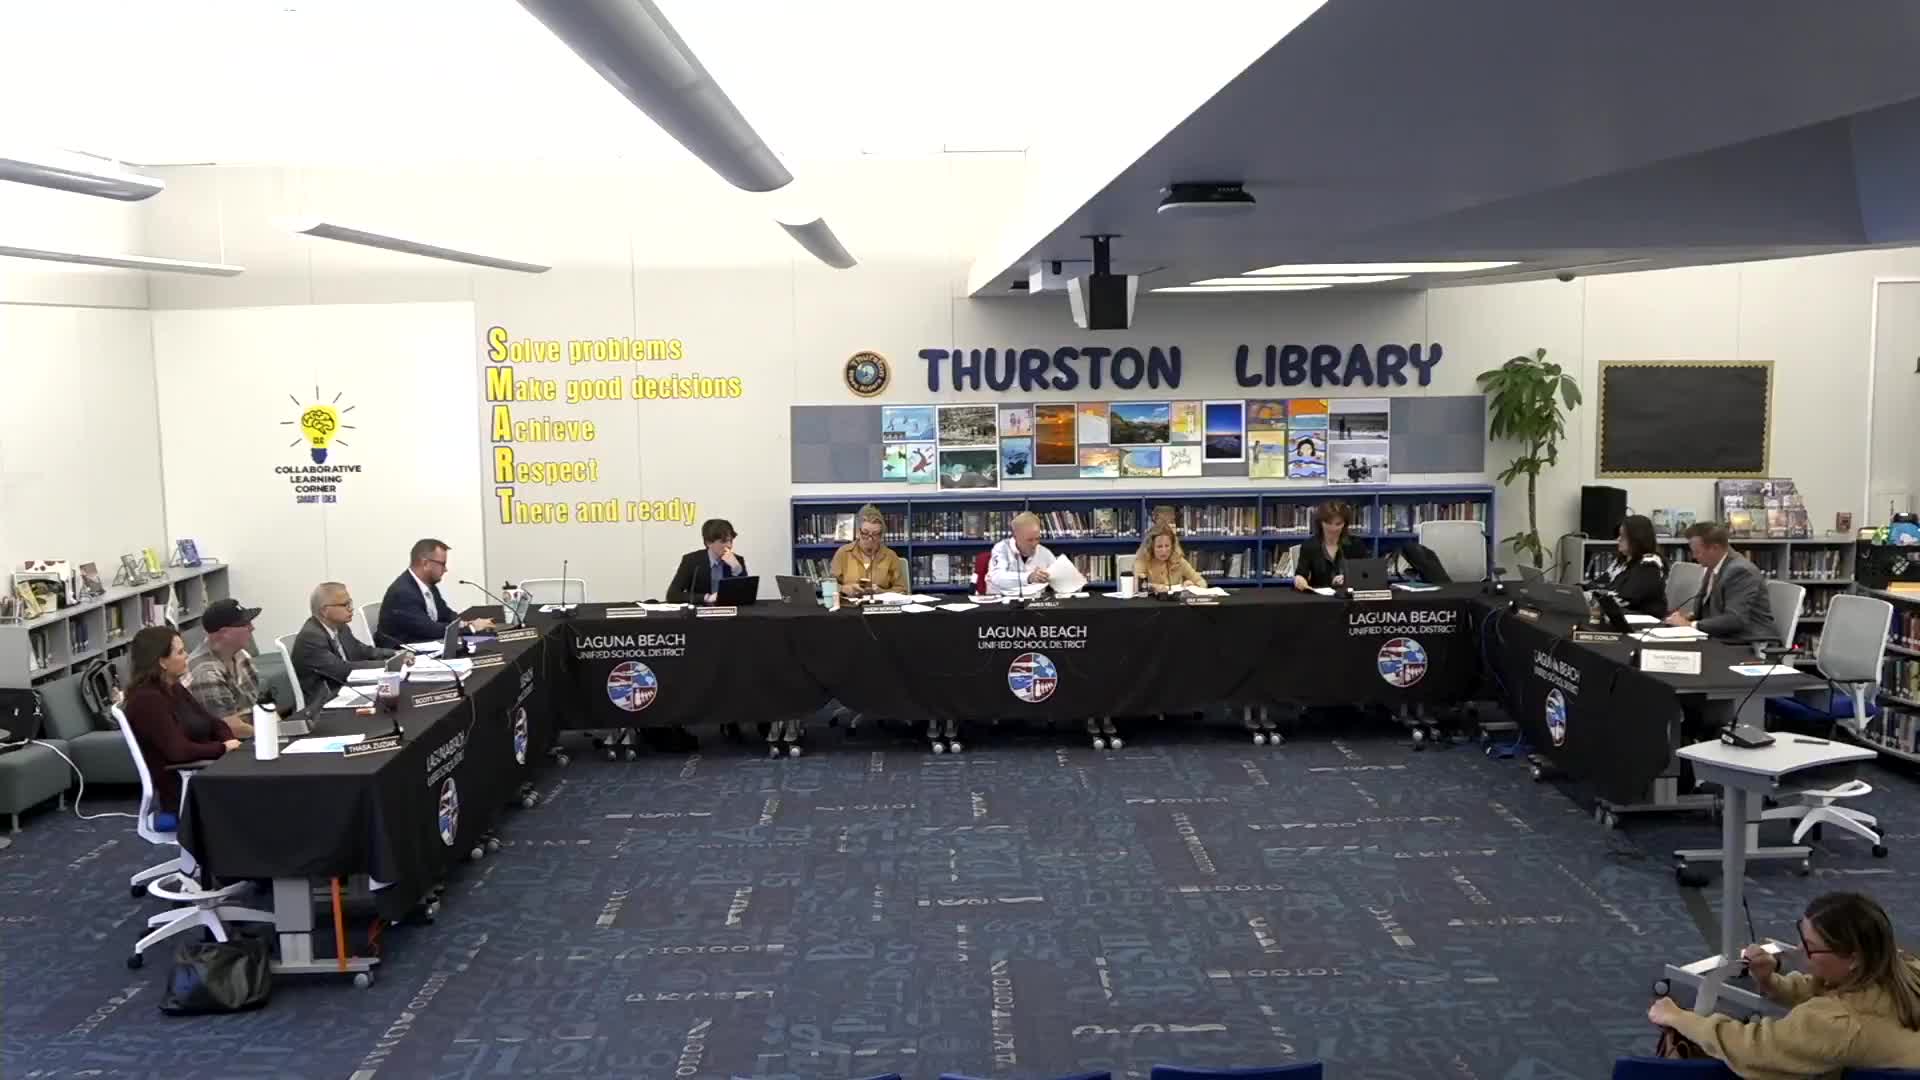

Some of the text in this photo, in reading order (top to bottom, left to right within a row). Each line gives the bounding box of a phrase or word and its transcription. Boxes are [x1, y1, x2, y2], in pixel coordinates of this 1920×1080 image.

[487, 326, 684, 364] Solve problems
[918, 346, 1182, 392] THURSTON
[1235, 343, 1443, 387] LIBRARY
[485, 366, 743, 404] Make good decisions
[490, 404, 596, 443] Achieve
[274, 465, 362, 474] COLLABORATIVE
[493, 446, 599, 485] Respect
[290, 475, 343, 484] LEARNING
[295, 485, 337, 493] CORNER
[495, 486, 697, 526] There and ready
[1349, 610, 1457, 625] LAGUNA BEACH
[978, 625, 1088, 639] LAGUNA BEACH
[1349, 626, 1381, 636] UNIFIED
[1383, 625, 1419, 635] SCHOOL
[576, 633, 686, 649] LAGUNA BEACH
[978, 640, 1086, 649] UNIFIED SCHOOL DISTRICT
[576, 648, 686, 659] UNIFIED SCHOOL DISTRICT
